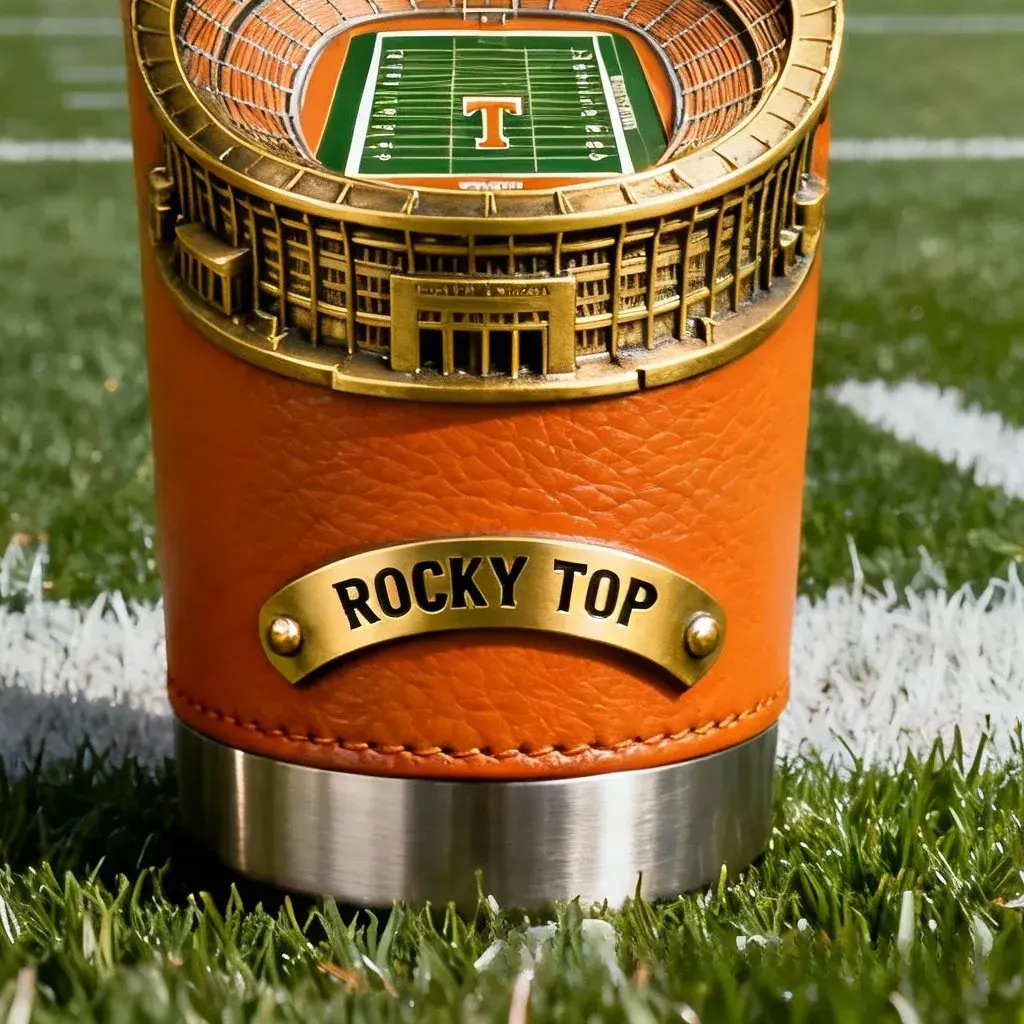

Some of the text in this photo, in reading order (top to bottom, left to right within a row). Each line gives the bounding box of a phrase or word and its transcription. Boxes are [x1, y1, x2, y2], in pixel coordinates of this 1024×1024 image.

[462, 96, 522, 150] T
[331, 555, 659, 630] ROCKY TOP
